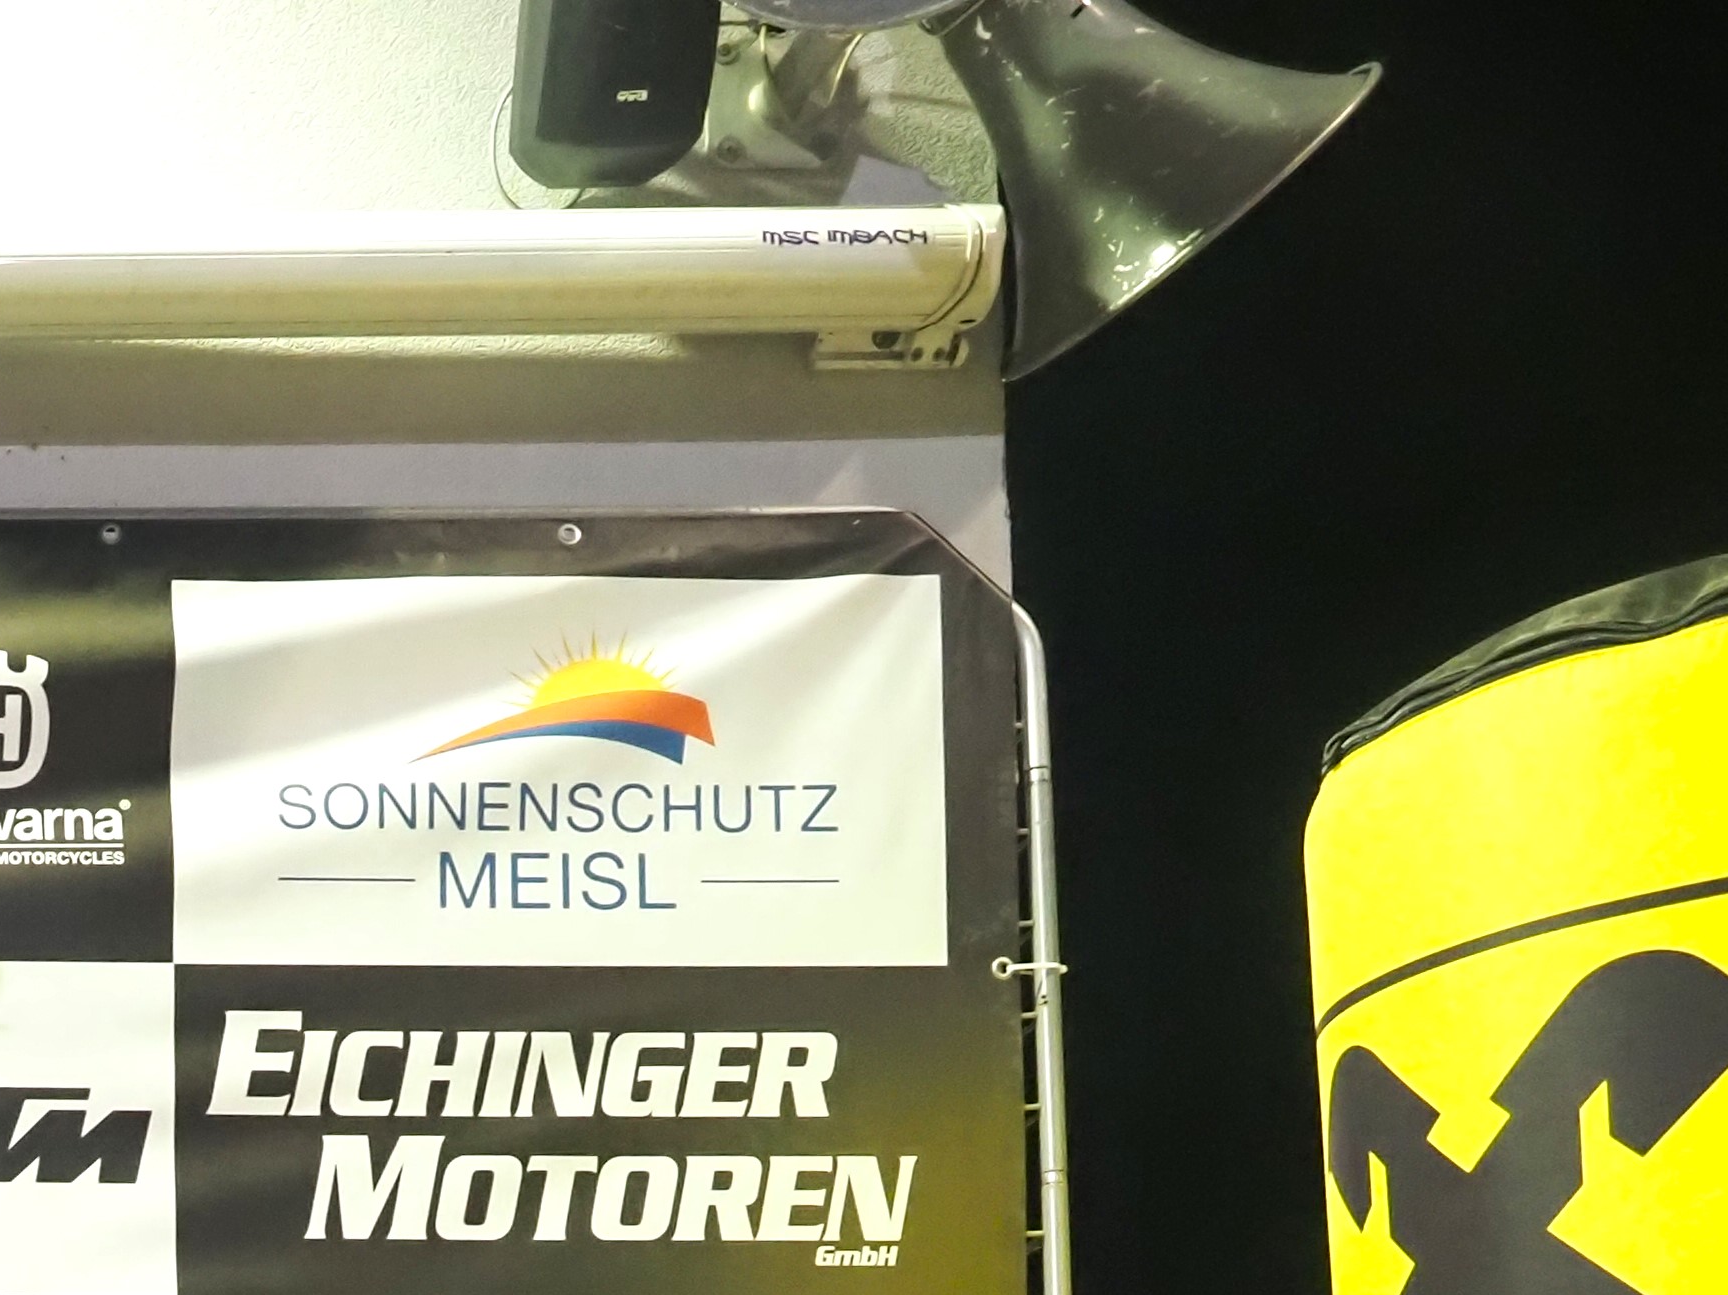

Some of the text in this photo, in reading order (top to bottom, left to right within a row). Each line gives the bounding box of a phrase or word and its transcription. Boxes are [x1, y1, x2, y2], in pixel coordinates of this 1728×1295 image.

[828, 229, 927, 245] IMBACH
[277, 781, 839, 836] SONNENSCHUTZ
[437, 851, 677, 912] MEISL
[207, 1010, 838, 1120] EICHINGER
[303, 1134, 918, 1243] MOTOREN
[814, 1245, 898, 1267] GmbH
